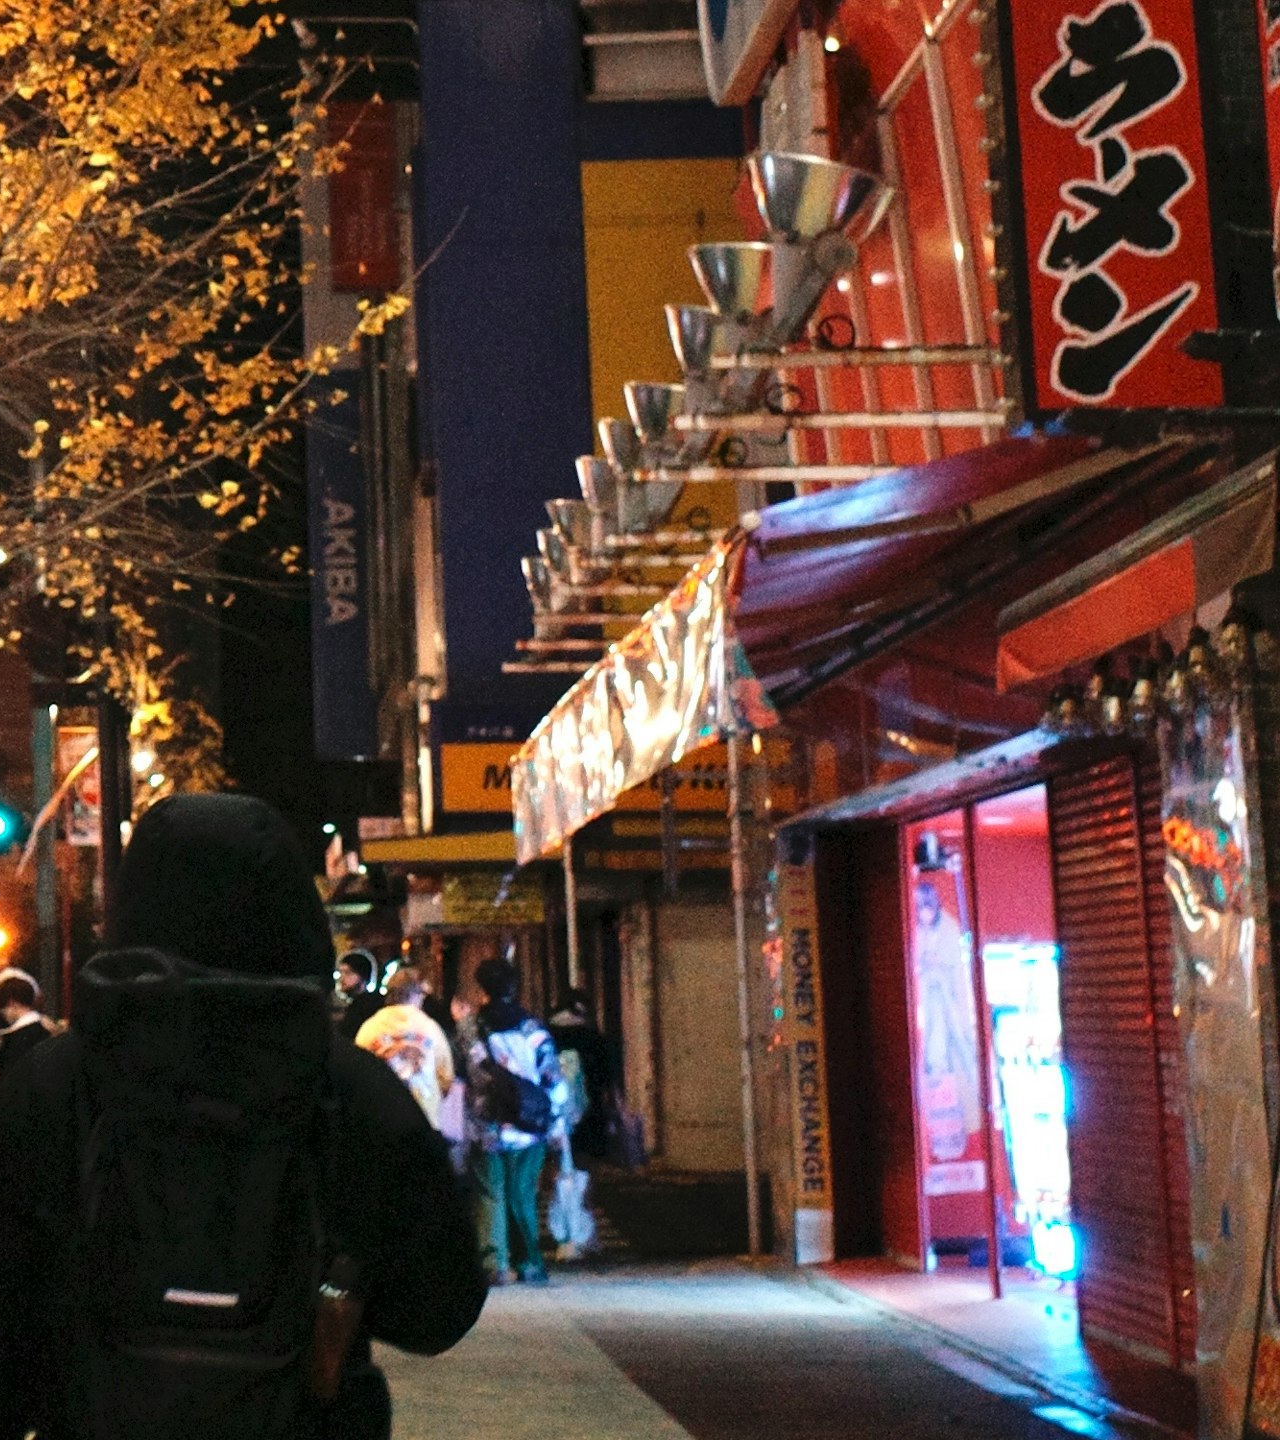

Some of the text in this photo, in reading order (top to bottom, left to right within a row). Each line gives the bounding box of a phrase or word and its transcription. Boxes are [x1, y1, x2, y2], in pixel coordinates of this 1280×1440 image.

[322, 496, 358, 626] AKIBA
[791, 928, 817, 1027] MONEY
[796, 1039, 825, 1194] EXCHANGE
